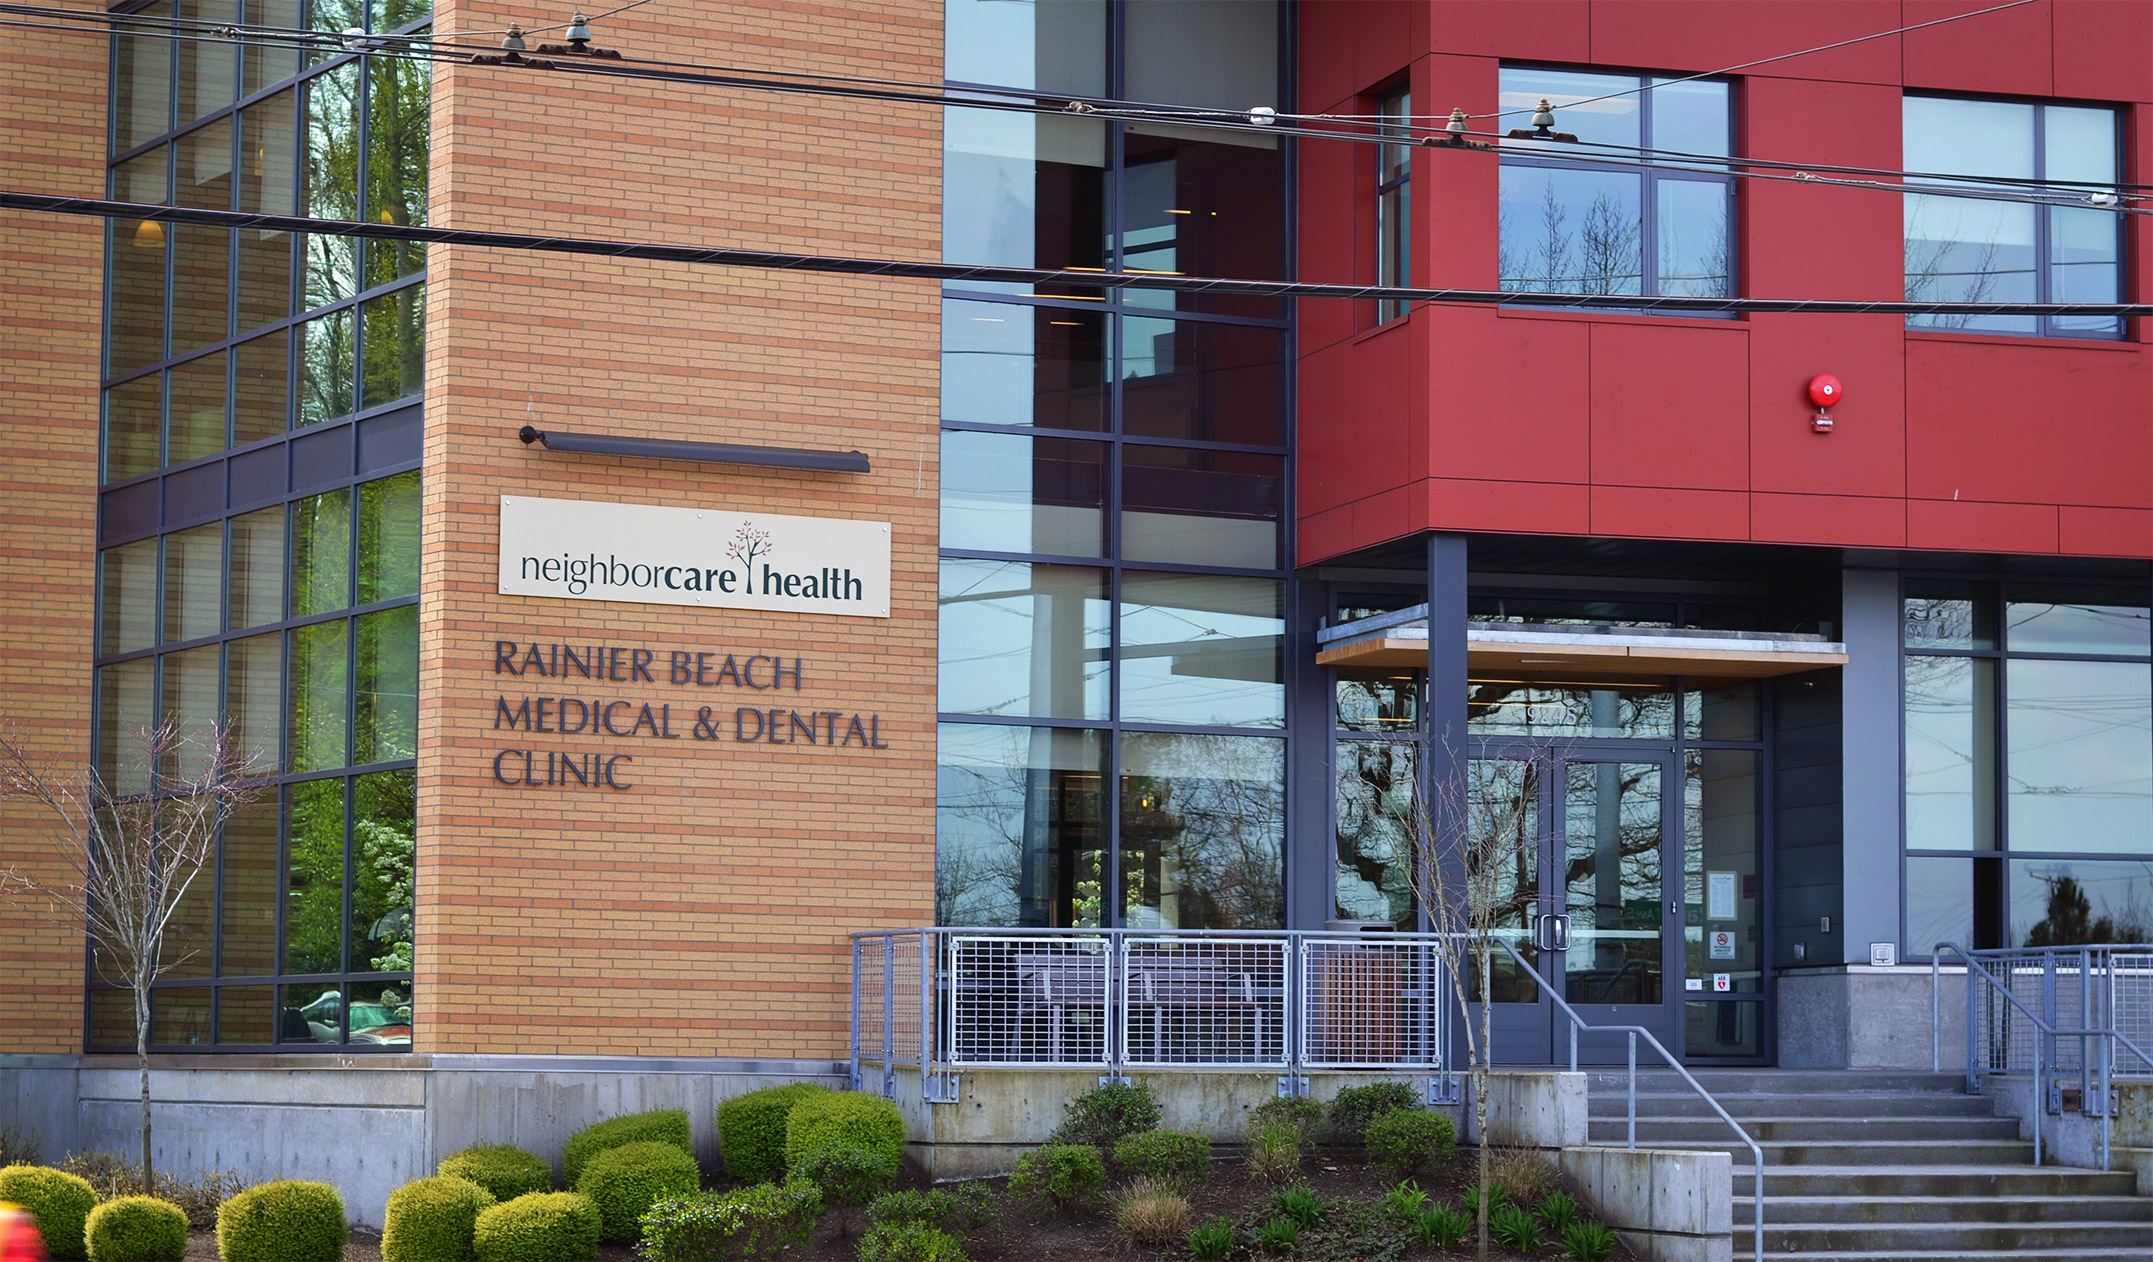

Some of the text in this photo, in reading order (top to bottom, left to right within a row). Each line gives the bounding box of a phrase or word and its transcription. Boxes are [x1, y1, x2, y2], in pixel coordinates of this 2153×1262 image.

[521, 553, 863, 601] neighborcare health
[495, 640, 803, 690] RAINIER BEACH
[494, 695, 889, 749] MEDICAL & DENTAL
[1527, 706, 1577, 725] 9245
[493, 749, 634, 790] CLINIC
